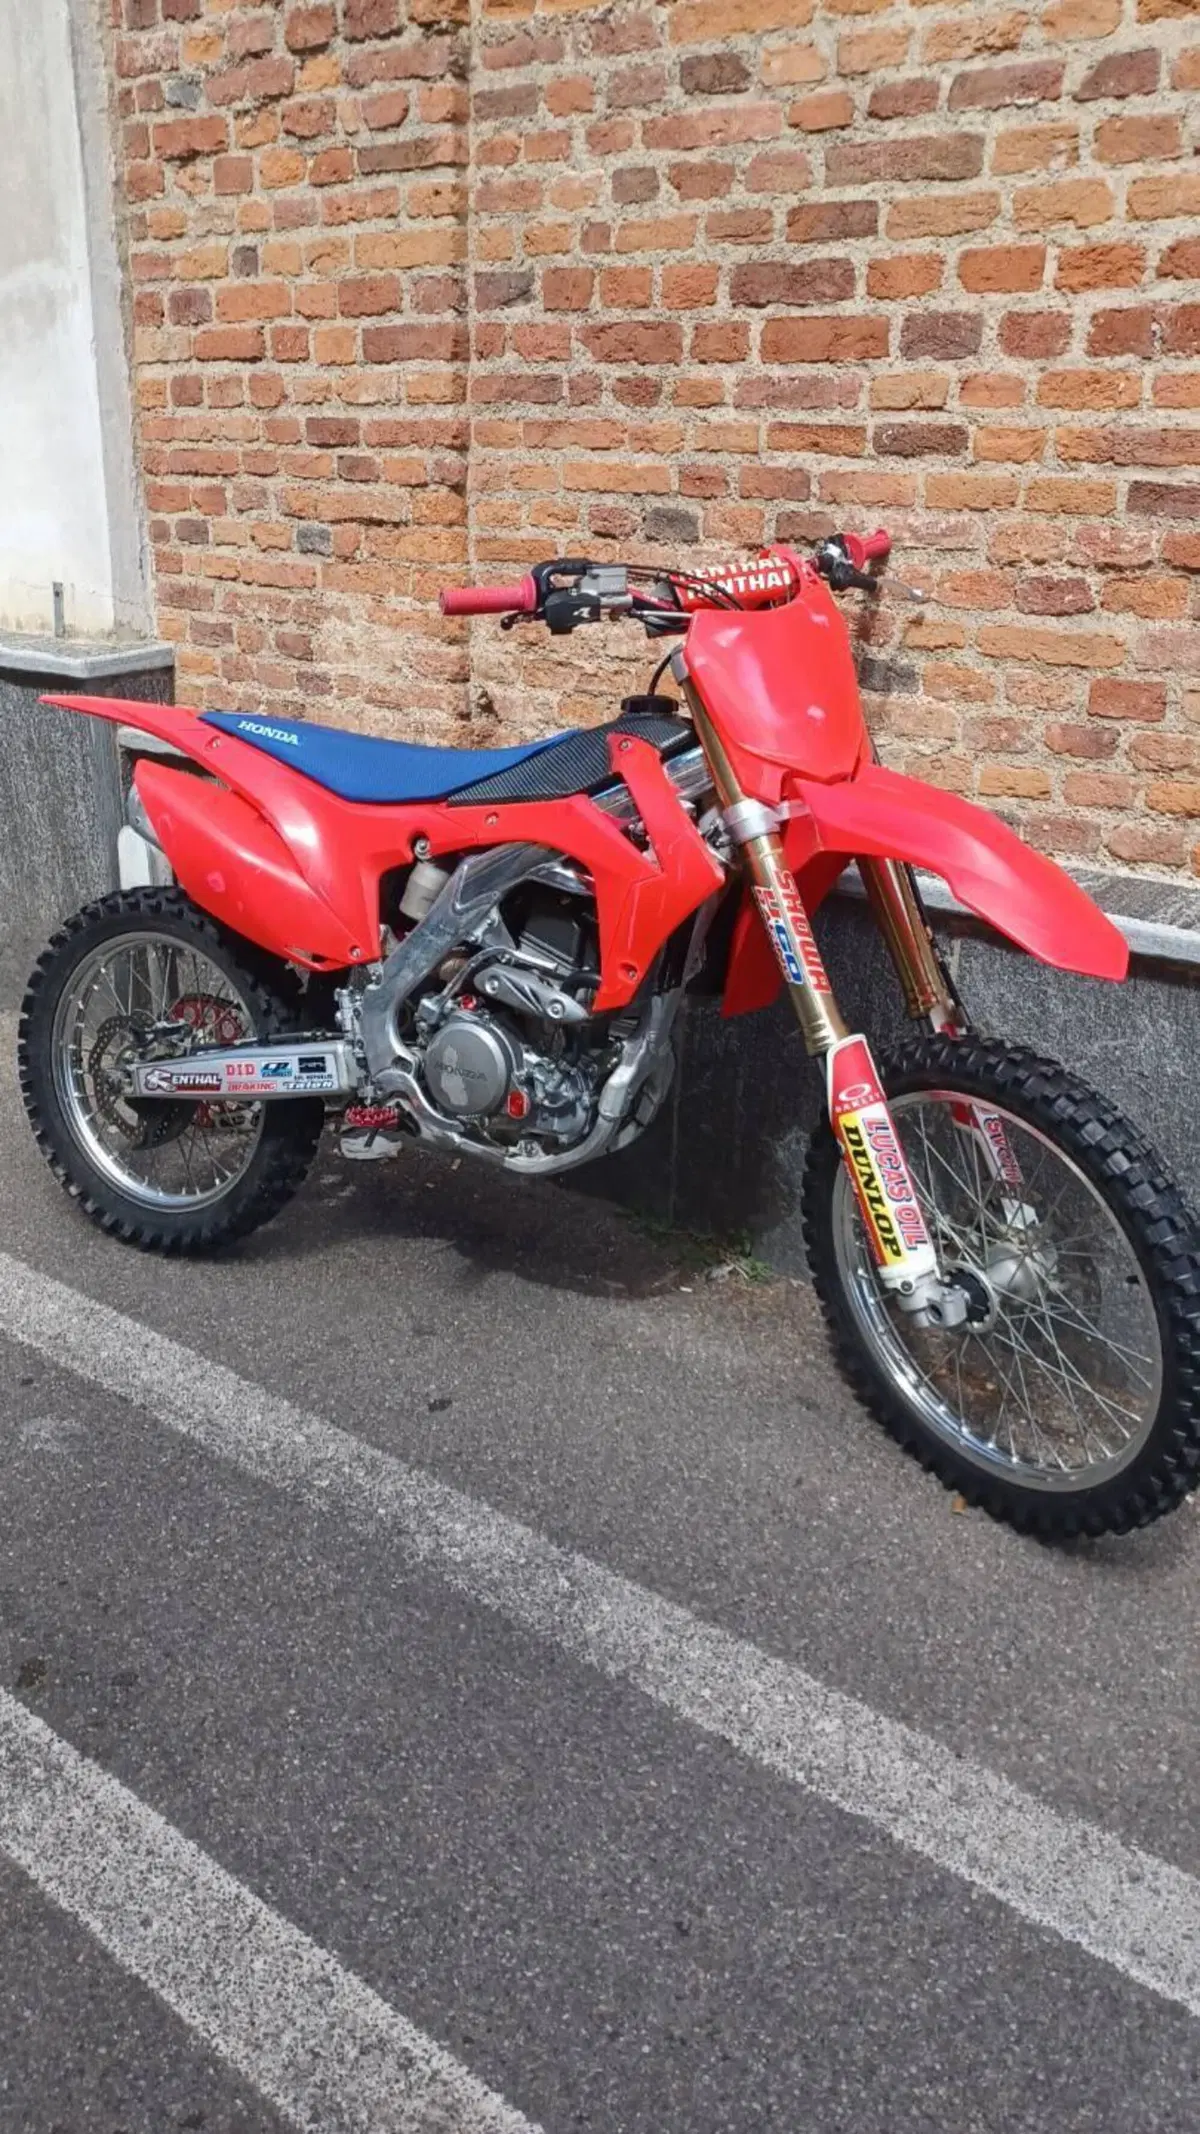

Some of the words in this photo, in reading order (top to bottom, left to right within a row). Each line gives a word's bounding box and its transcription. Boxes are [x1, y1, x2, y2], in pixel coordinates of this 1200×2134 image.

[237, 720, 299, 745] HONDA
[774, 870, 832, 993] SHOWA
[226, 1063, 256, 1076] DID
[433, 1061, 489, 1082] HONDA
[842, 1123, 902, 1258] DUNLOP
[862, 1117, 909, 1203] LUCAS
[895, 1204, 929, 1251] OIL
